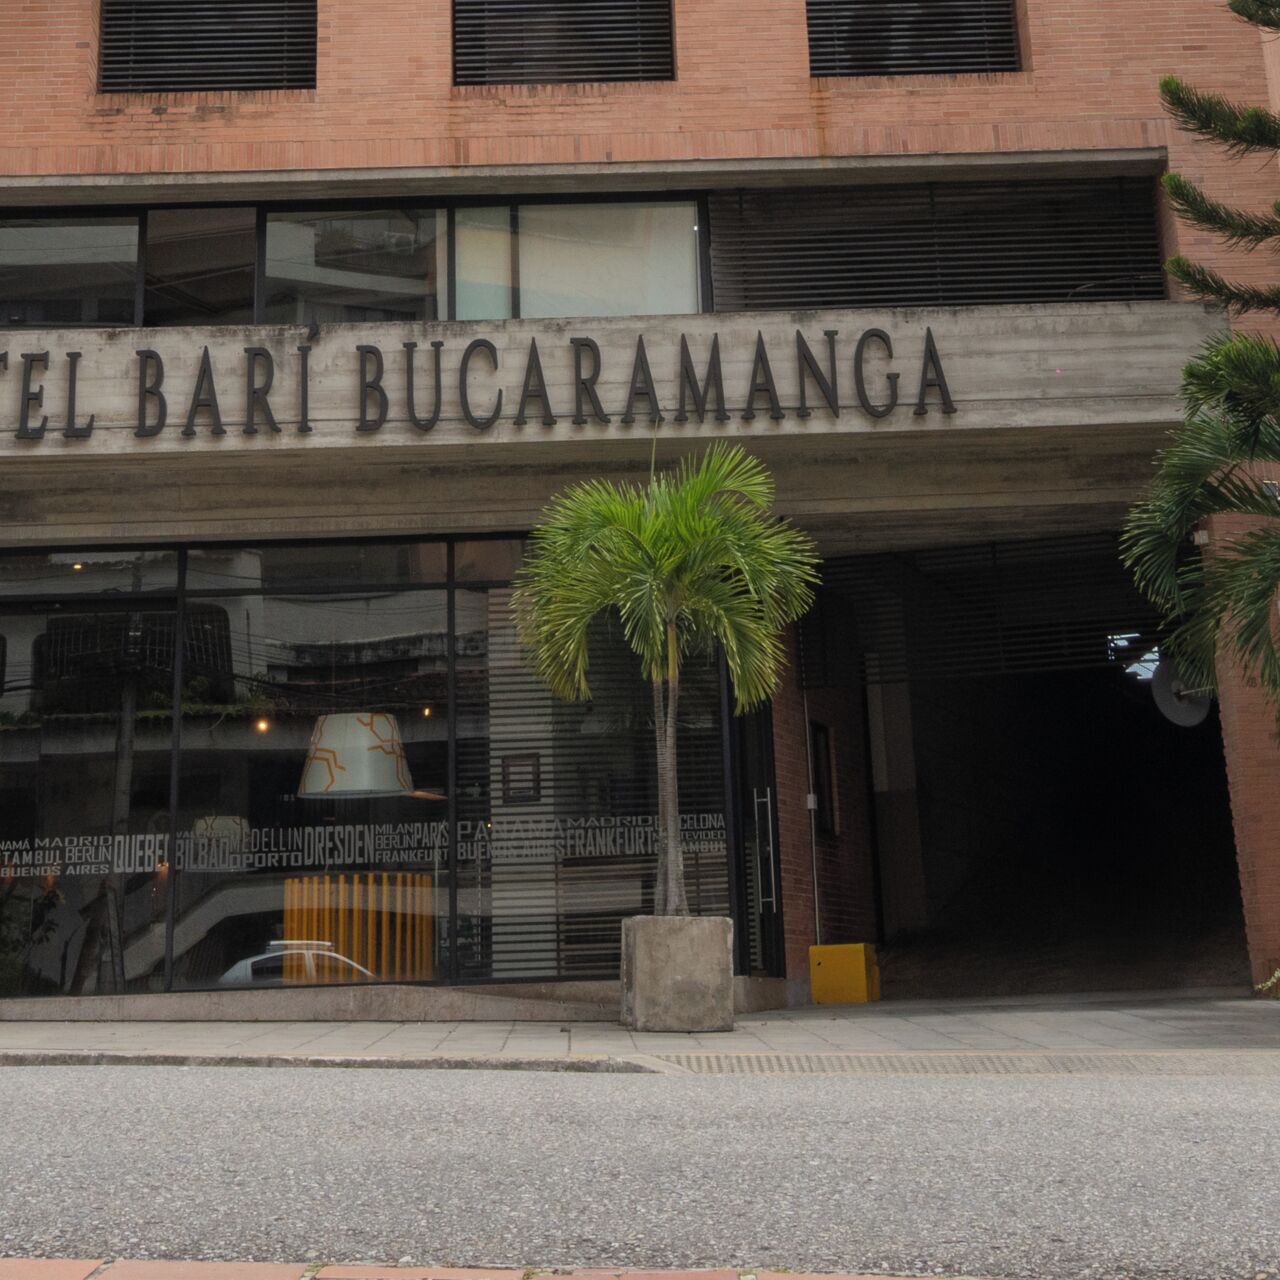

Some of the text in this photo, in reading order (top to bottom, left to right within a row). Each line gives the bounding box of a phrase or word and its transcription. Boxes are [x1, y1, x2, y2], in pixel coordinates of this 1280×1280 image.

[355, 326, 958, 432] BUCARAMANGA
[375, 823, 414, 835] MILAN
[567, 816, 653, 828] MADRID
[34, 834, 112, 848] MADRID
[375, 834, 415, 850] BERLIN
[414, 822, 450, 848] PARIS
[567, 826, 654, 857] FRANKFURT
[175, 838, 230, 869] BILBAO
[303, 824, 375, 866] DRESDEN
[65, 846, 112, 863] BERLIN
[229, 851, 303, 869] OPORTO
[375, 848, 450, 863] FRANKFURT
[0, 864, 110, 878] BUENOS AIRES
